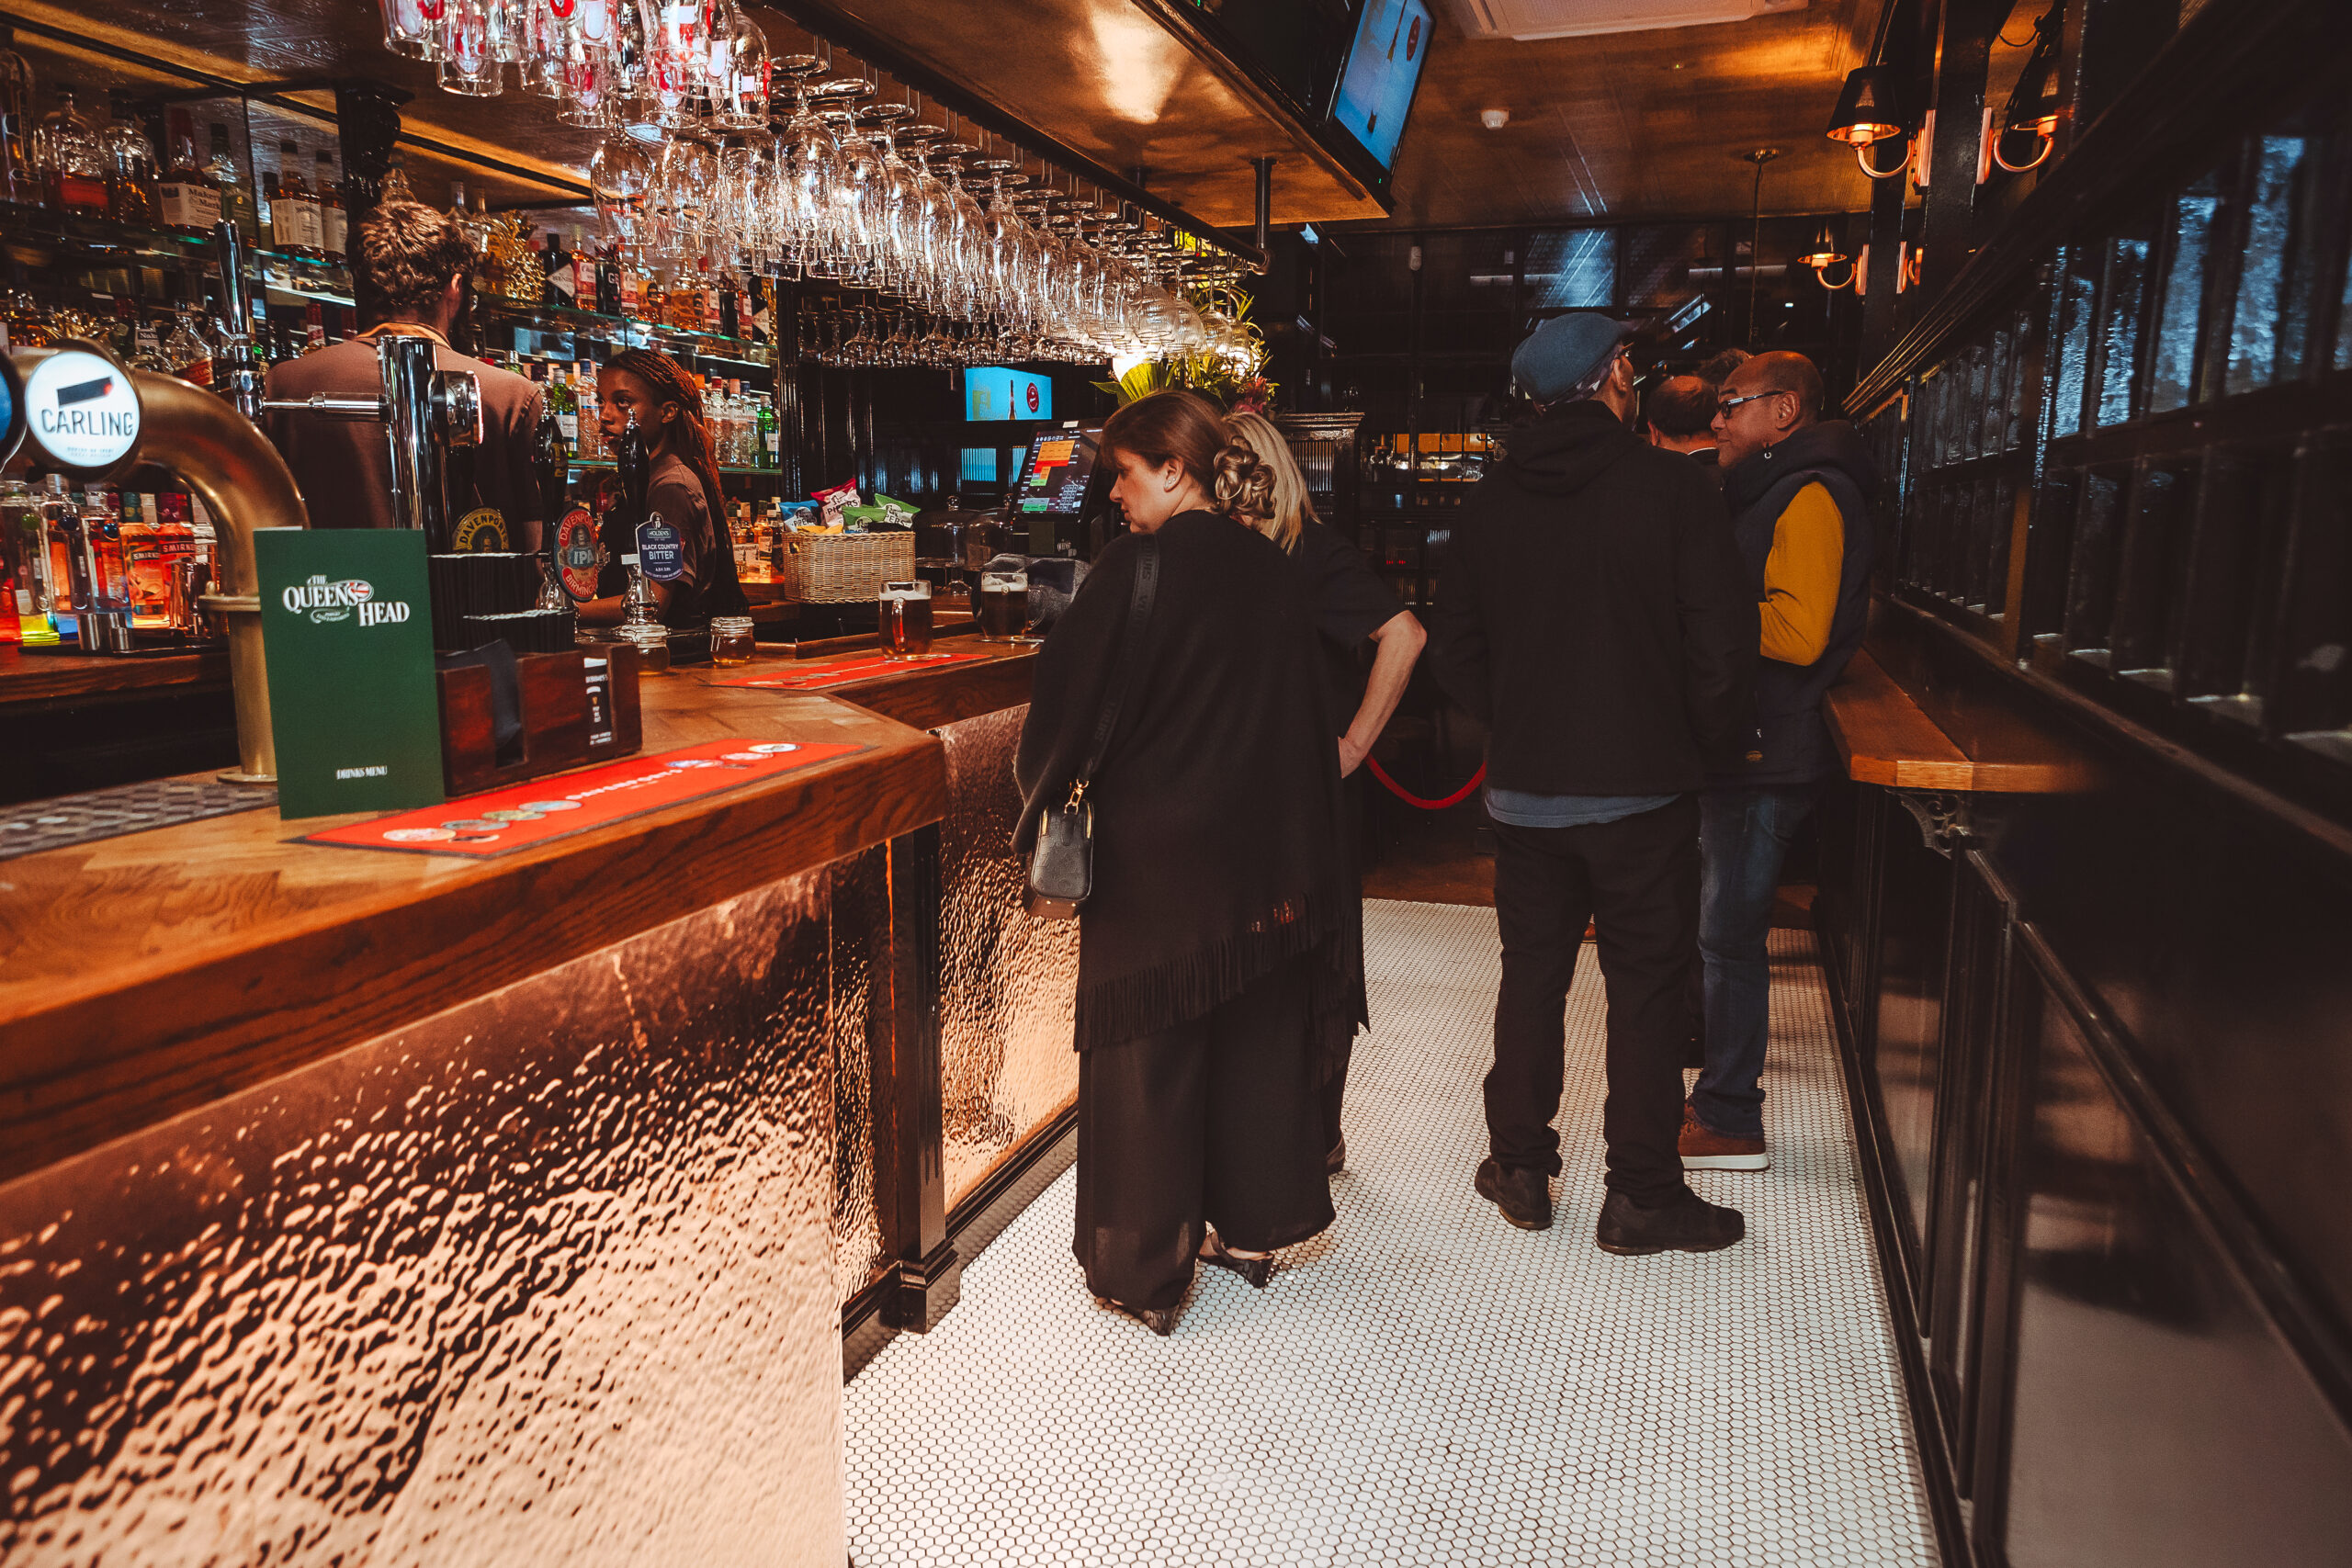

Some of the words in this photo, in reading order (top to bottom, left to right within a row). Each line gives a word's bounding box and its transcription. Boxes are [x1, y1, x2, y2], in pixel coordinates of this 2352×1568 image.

[41, 409, 133, 436] CARLING
[573, 549, 594, 565] IPA
[649, 550, 674, 560] BITTER
[357, 601, 411, 626] HEAD
[336, 767, 365, 780] DRINKS
[365, 764, 388, 777] MENU
